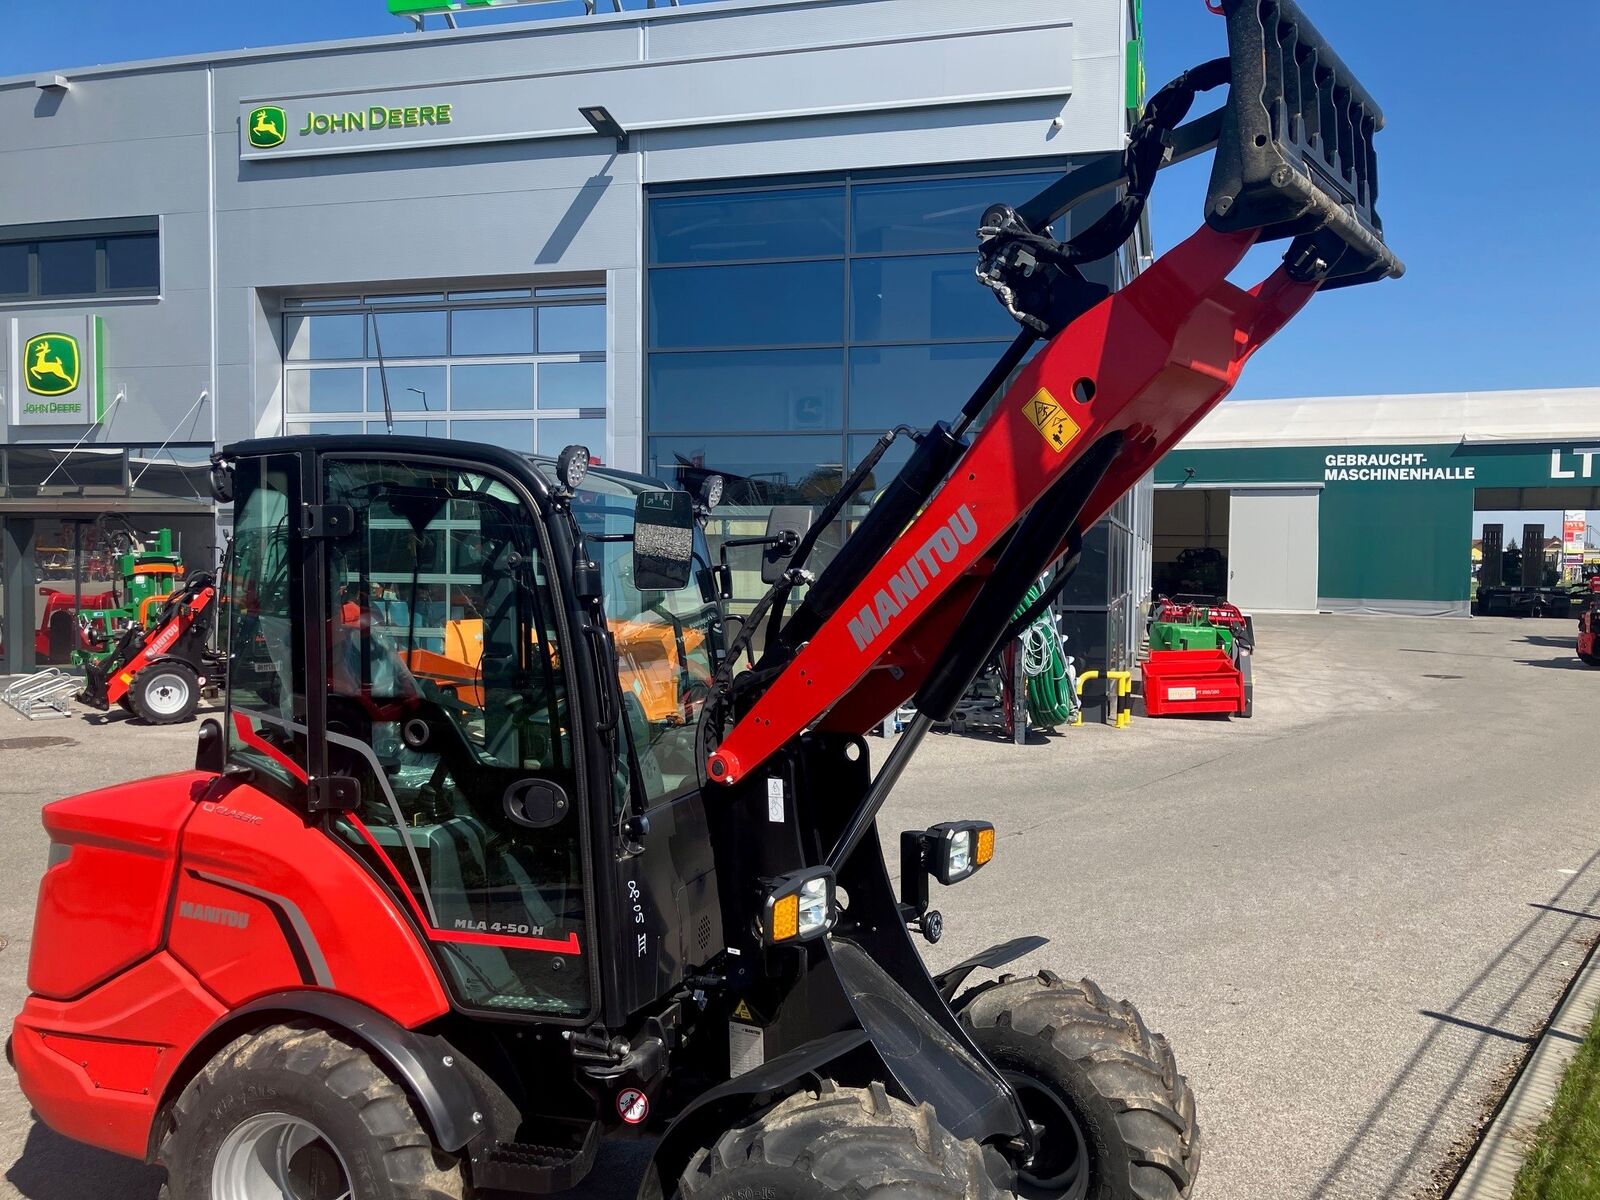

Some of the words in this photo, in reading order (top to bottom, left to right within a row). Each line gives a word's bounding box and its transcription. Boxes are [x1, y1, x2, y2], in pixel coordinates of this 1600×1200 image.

[300, 111, 366, 136] JOHN
[369, 104, 452, 131] DEERE
[24, 402, 48, 414] JOHN
[50, 402, 82, 413] DEERE
[1325, 453, 1427, 467] GEBRAUCHT-
[1324, 467, 1475, 481] MASCHINENHALLE
[847, 503, 978, 653] MANITOU
[145, 624, 179, 657] MANITOU
[179, 900, 249, 929] MANITOU
[455, 919, 487, 931] MLA
[490, 922, 529, 934] 4-50
[532, 926, 544, 936] H
